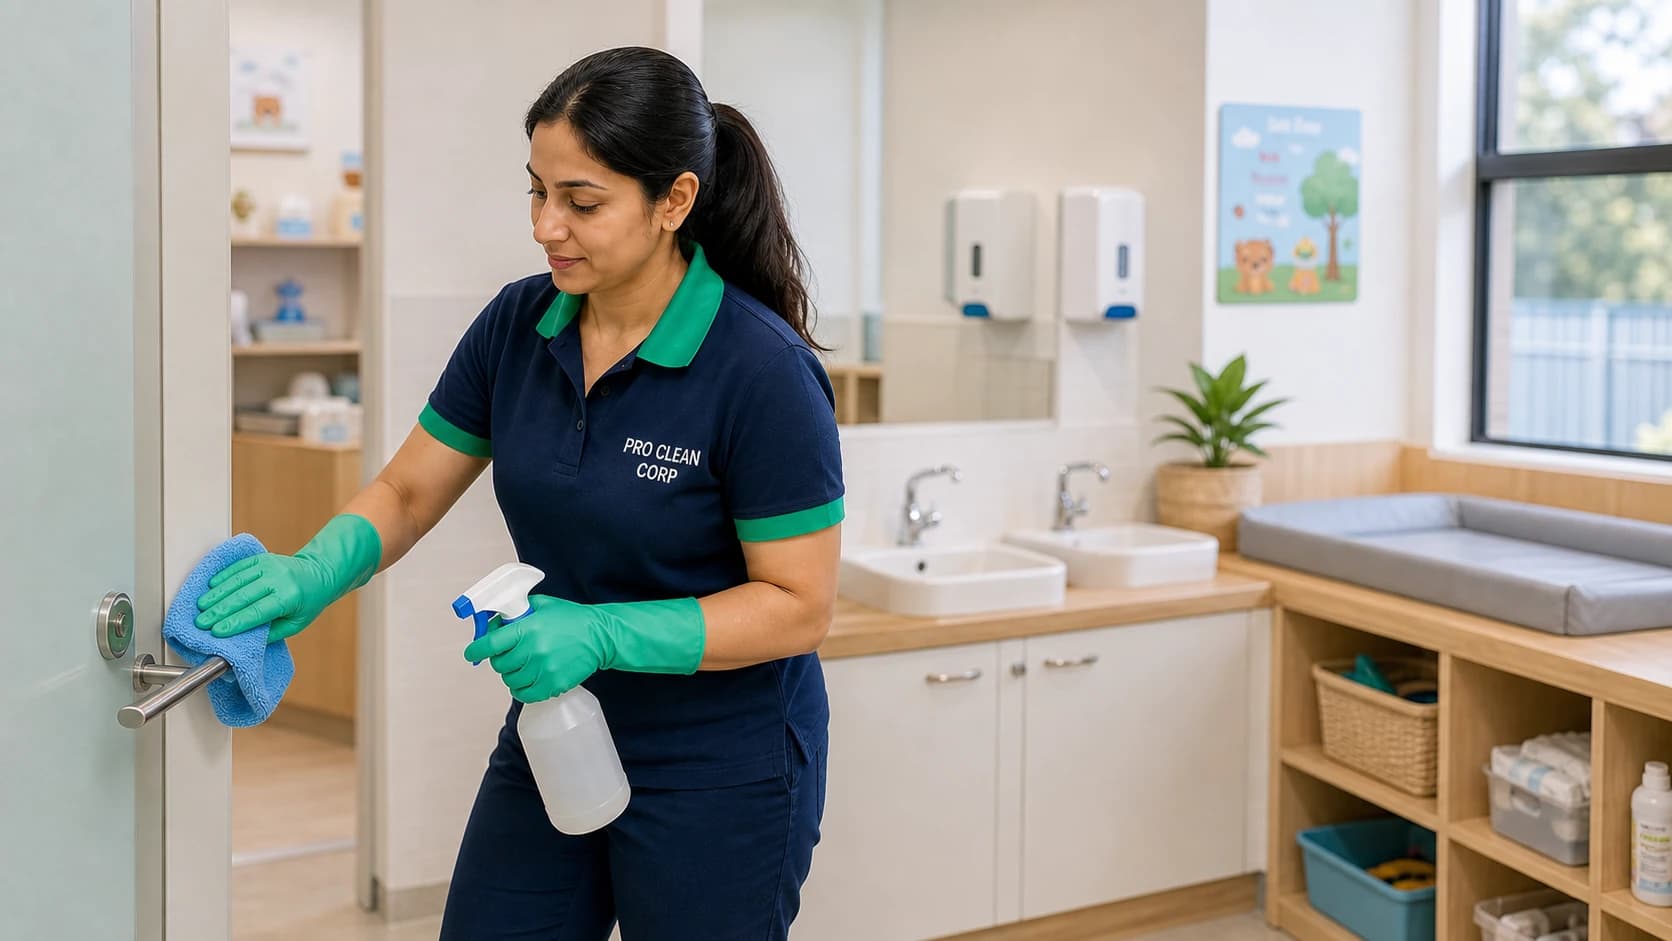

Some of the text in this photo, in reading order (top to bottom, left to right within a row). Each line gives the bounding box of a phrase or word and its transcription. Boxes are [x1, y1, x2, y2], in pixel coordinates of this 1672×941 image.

[623, 437, 701, 467] PRO CLEAN
[636, 462, 678, 484] CORP
